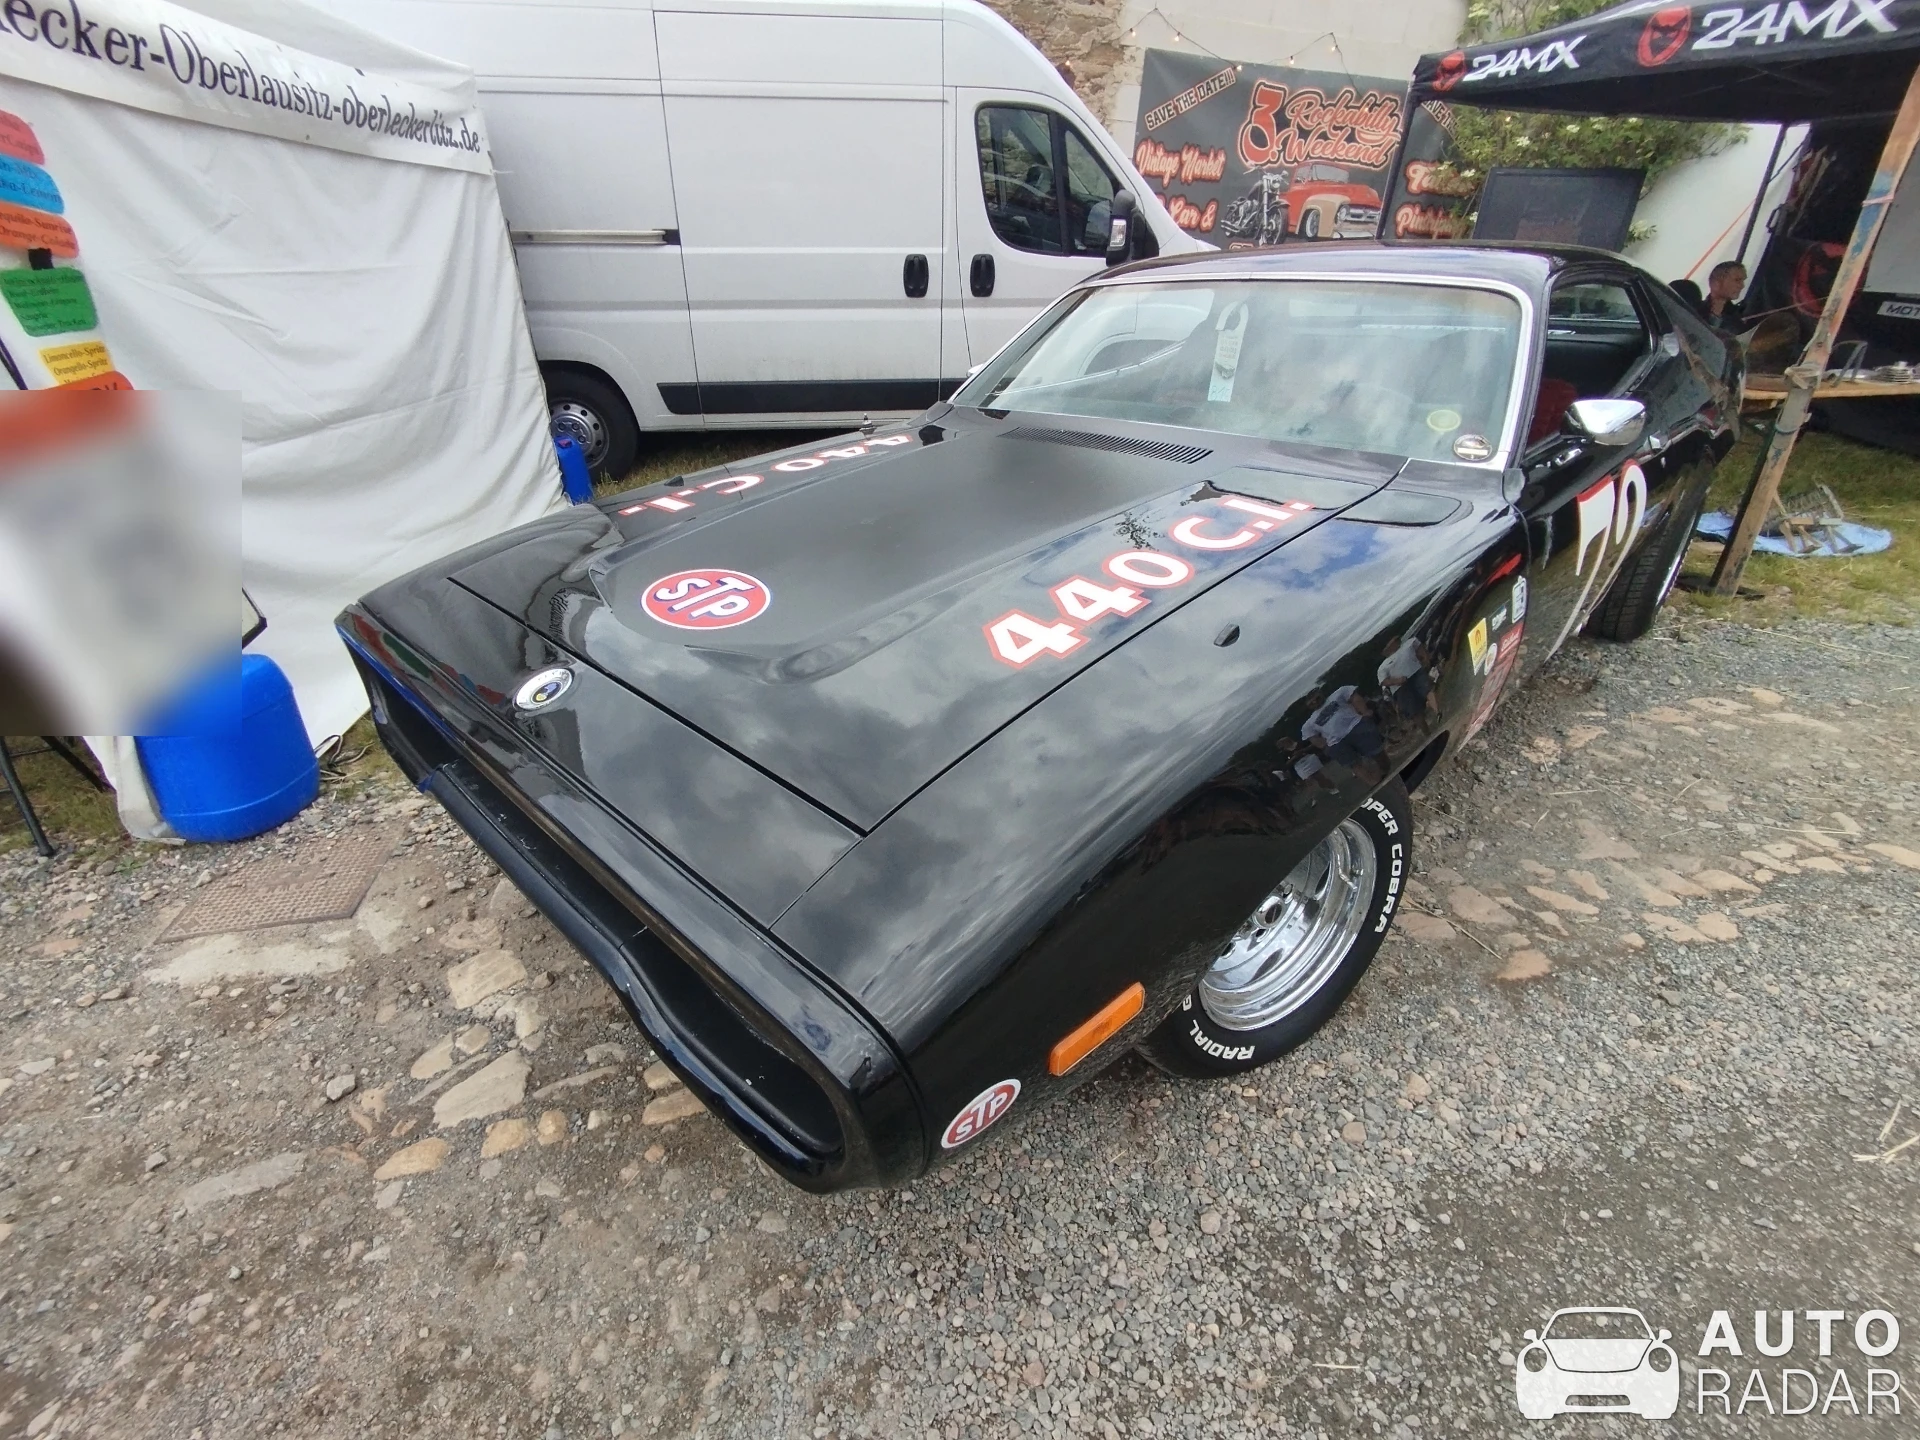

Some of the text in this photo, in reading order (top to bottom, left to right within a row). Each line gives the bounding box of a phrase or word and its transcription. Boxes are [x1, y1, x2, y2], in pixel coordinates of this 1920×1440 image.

[1692, 0, 1898, 50] 24MX
[0, 0, 481, 154] ecker-Oberlausitz-oberleckerlitz.de
[1463, 35, 1587, 81] 24MX
[1146, 71, 1234, 129] SAVE THE DATE!!!
[1286, 91, 1400, 145] Rockabilly
[1136, 140, 1226, 187] Vintage Market
[1275, 126, 1395, 165] Weekend
[1201, 201, 1217, 230] &
[653, 576, 757, 622] STP
[983, 494, 1317, 670] 440 C.I.
[1374, 843, 1403, 934] COBRA
[1189, 1019, 1256, 1060] RADIAL
[954, 1091, 1009, 1141] STP
